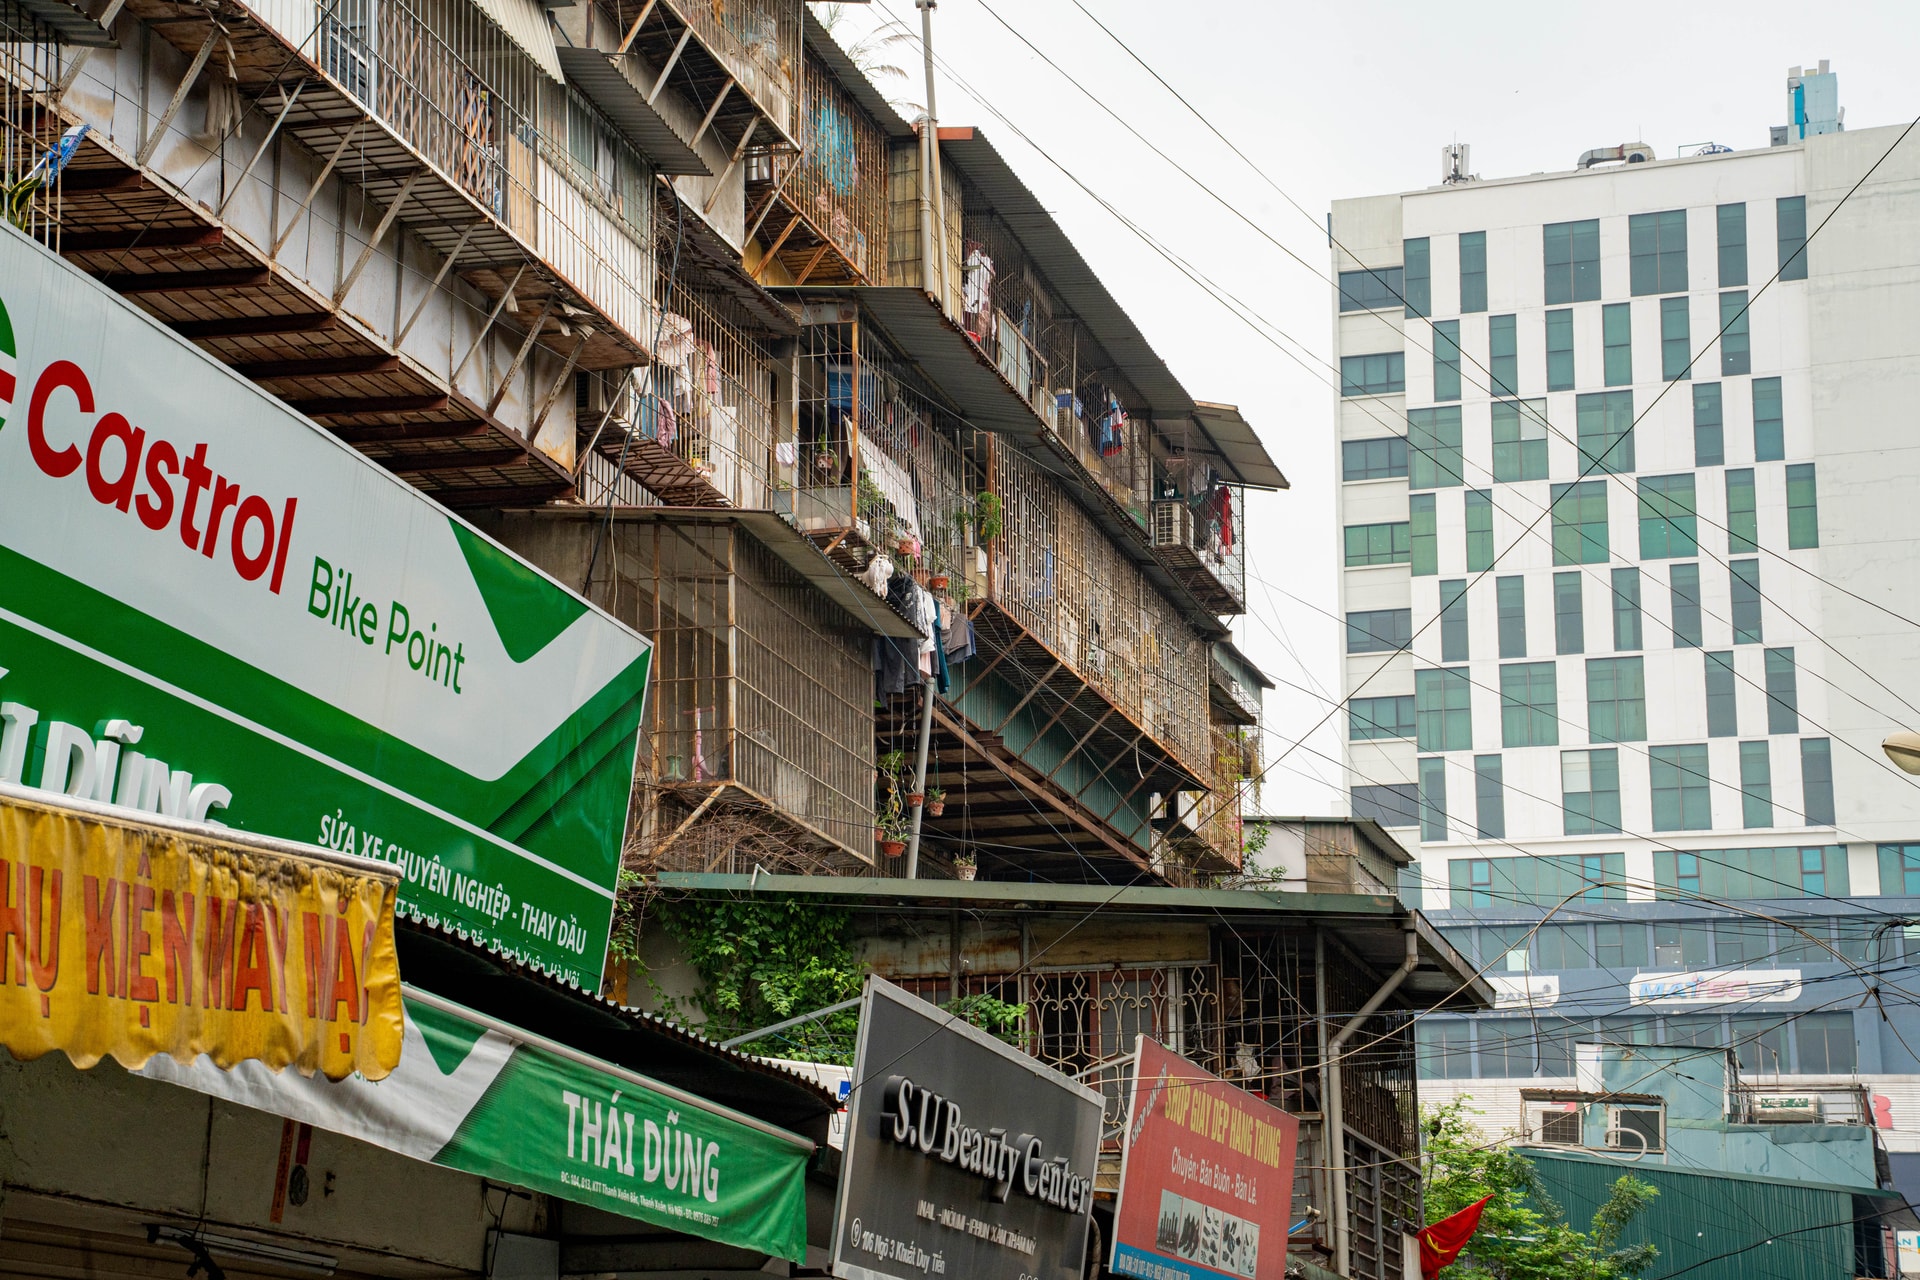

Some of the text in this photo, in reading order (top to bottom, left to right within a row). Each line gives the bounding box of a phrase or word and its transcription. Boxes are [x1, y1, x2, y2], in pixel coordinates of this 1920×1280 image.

[27, 360, 298, 595] Castrol
[308, 555, 465, 694] Bike Point
[83, 853, 195, 1028] KIỆN
[202, 895, 290, 1014] MAY
[318, 808, 356, 853] SỬA
[385, 843, 452, 897] CHUYÊN
[453, 873, 511, 929] NGHIỆP
[521, 902, 558, 942] THAY
[558, 914, 587, 955] DẦU
[562, 1089, 720, 1203] THÁI DŨNG
[893, 1078, 1090, 1215] S.U Beauty Center
[1165, 1072, 1191, 1127] SHOP
[1211, 1091, 1230, 1144] DÉP
[1229, 1100, 1254, 1157] HÀNG
[1172, 1146, 1199, 1185] Chuyên:
[1199, 1158, 1213, 1187] Bán
[1213, 1164, 1230, 1194] Buôn
[1235, 1173, 1247, 1201] Bán
[874, 1234, 889, 1261] Ngõ
[889, 1239, 895, 1258] 3
[895, 1240, 916, 1265] Khuất
[916, 1248, 930, 1274] Duy
